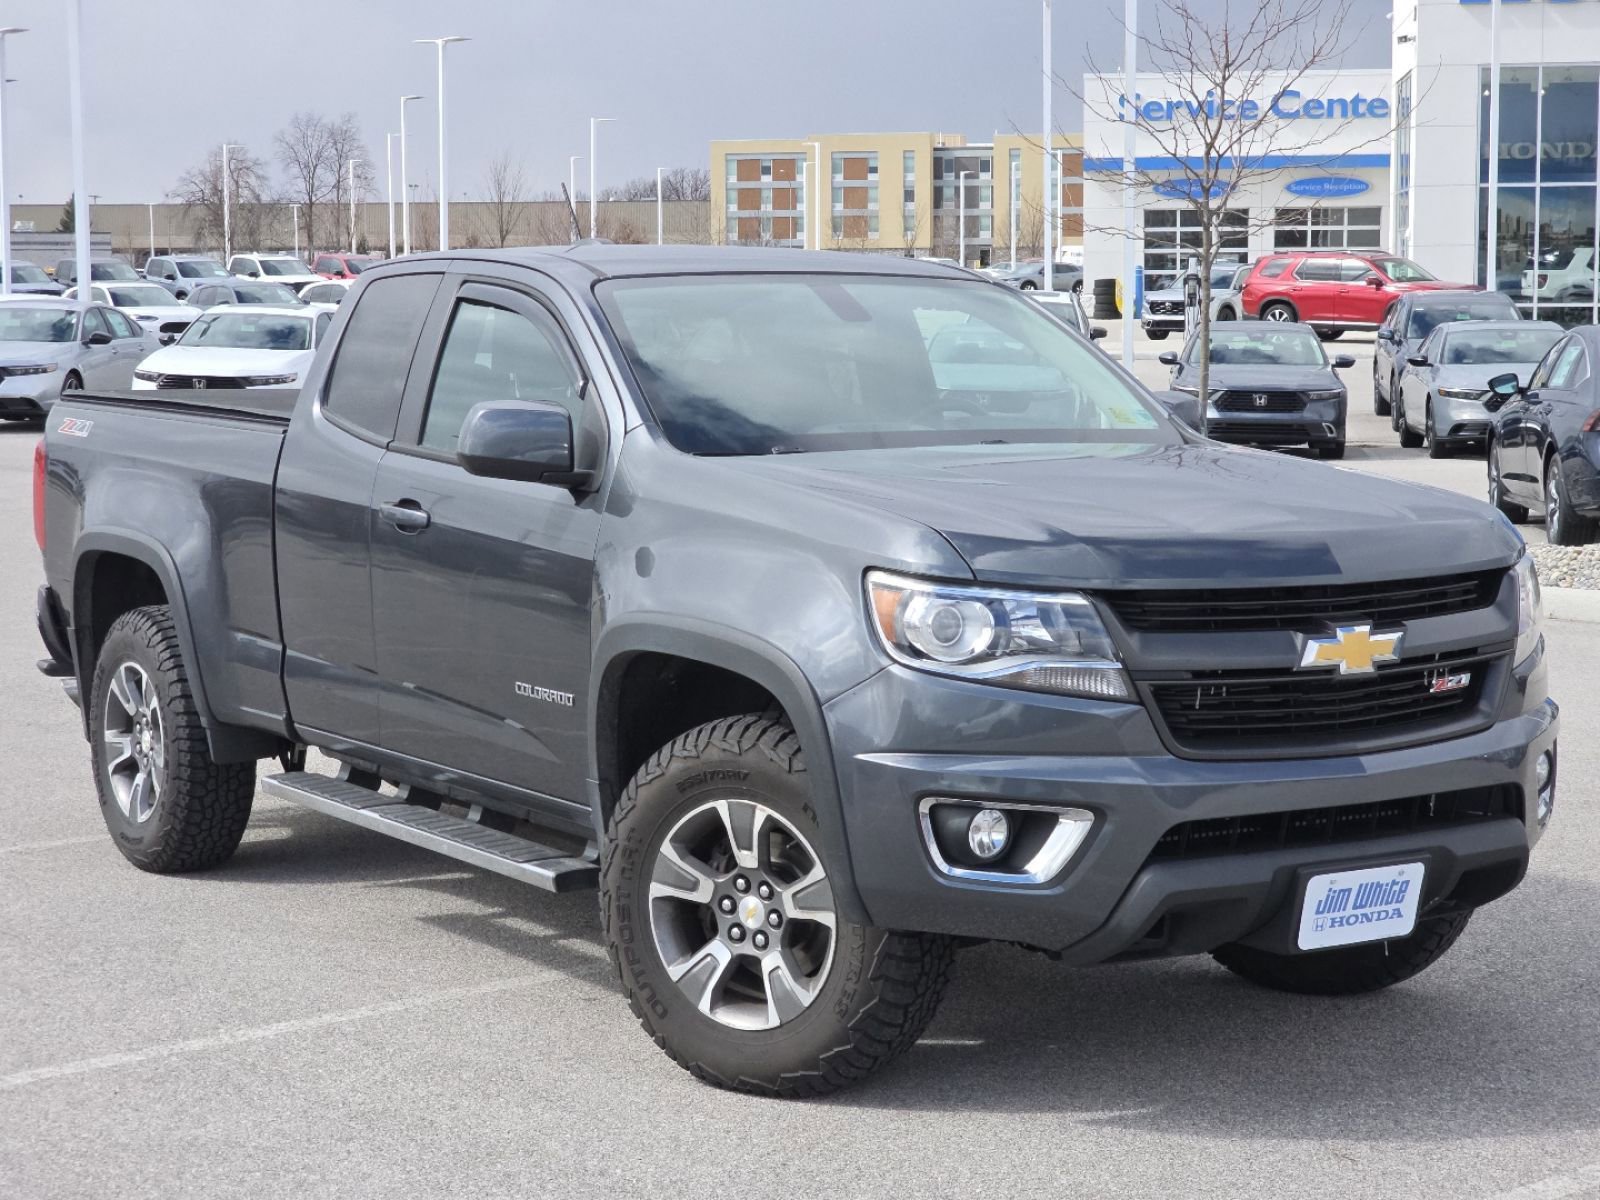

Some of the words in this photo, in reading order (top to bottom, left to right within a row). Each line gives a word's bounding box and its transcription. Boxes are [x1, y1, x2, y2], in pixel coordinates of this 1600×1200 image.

[1482, 141, 1597, 160] HOND
[1290, 183, 1322, 191] Service
[1323, 182, 1366, 192] Reception
[58, 417, 94, 437] Z71
[1430, 672, 1471, 693] Z71
[515, 681, 574, 706] COLORADO
[1314, 887, 1353, 916] Jim
[1351, 878, 1411, 911] White
[1328, 907, 1404, 929] HONDA
[616, 885, 669, 1020] OUTPOST
